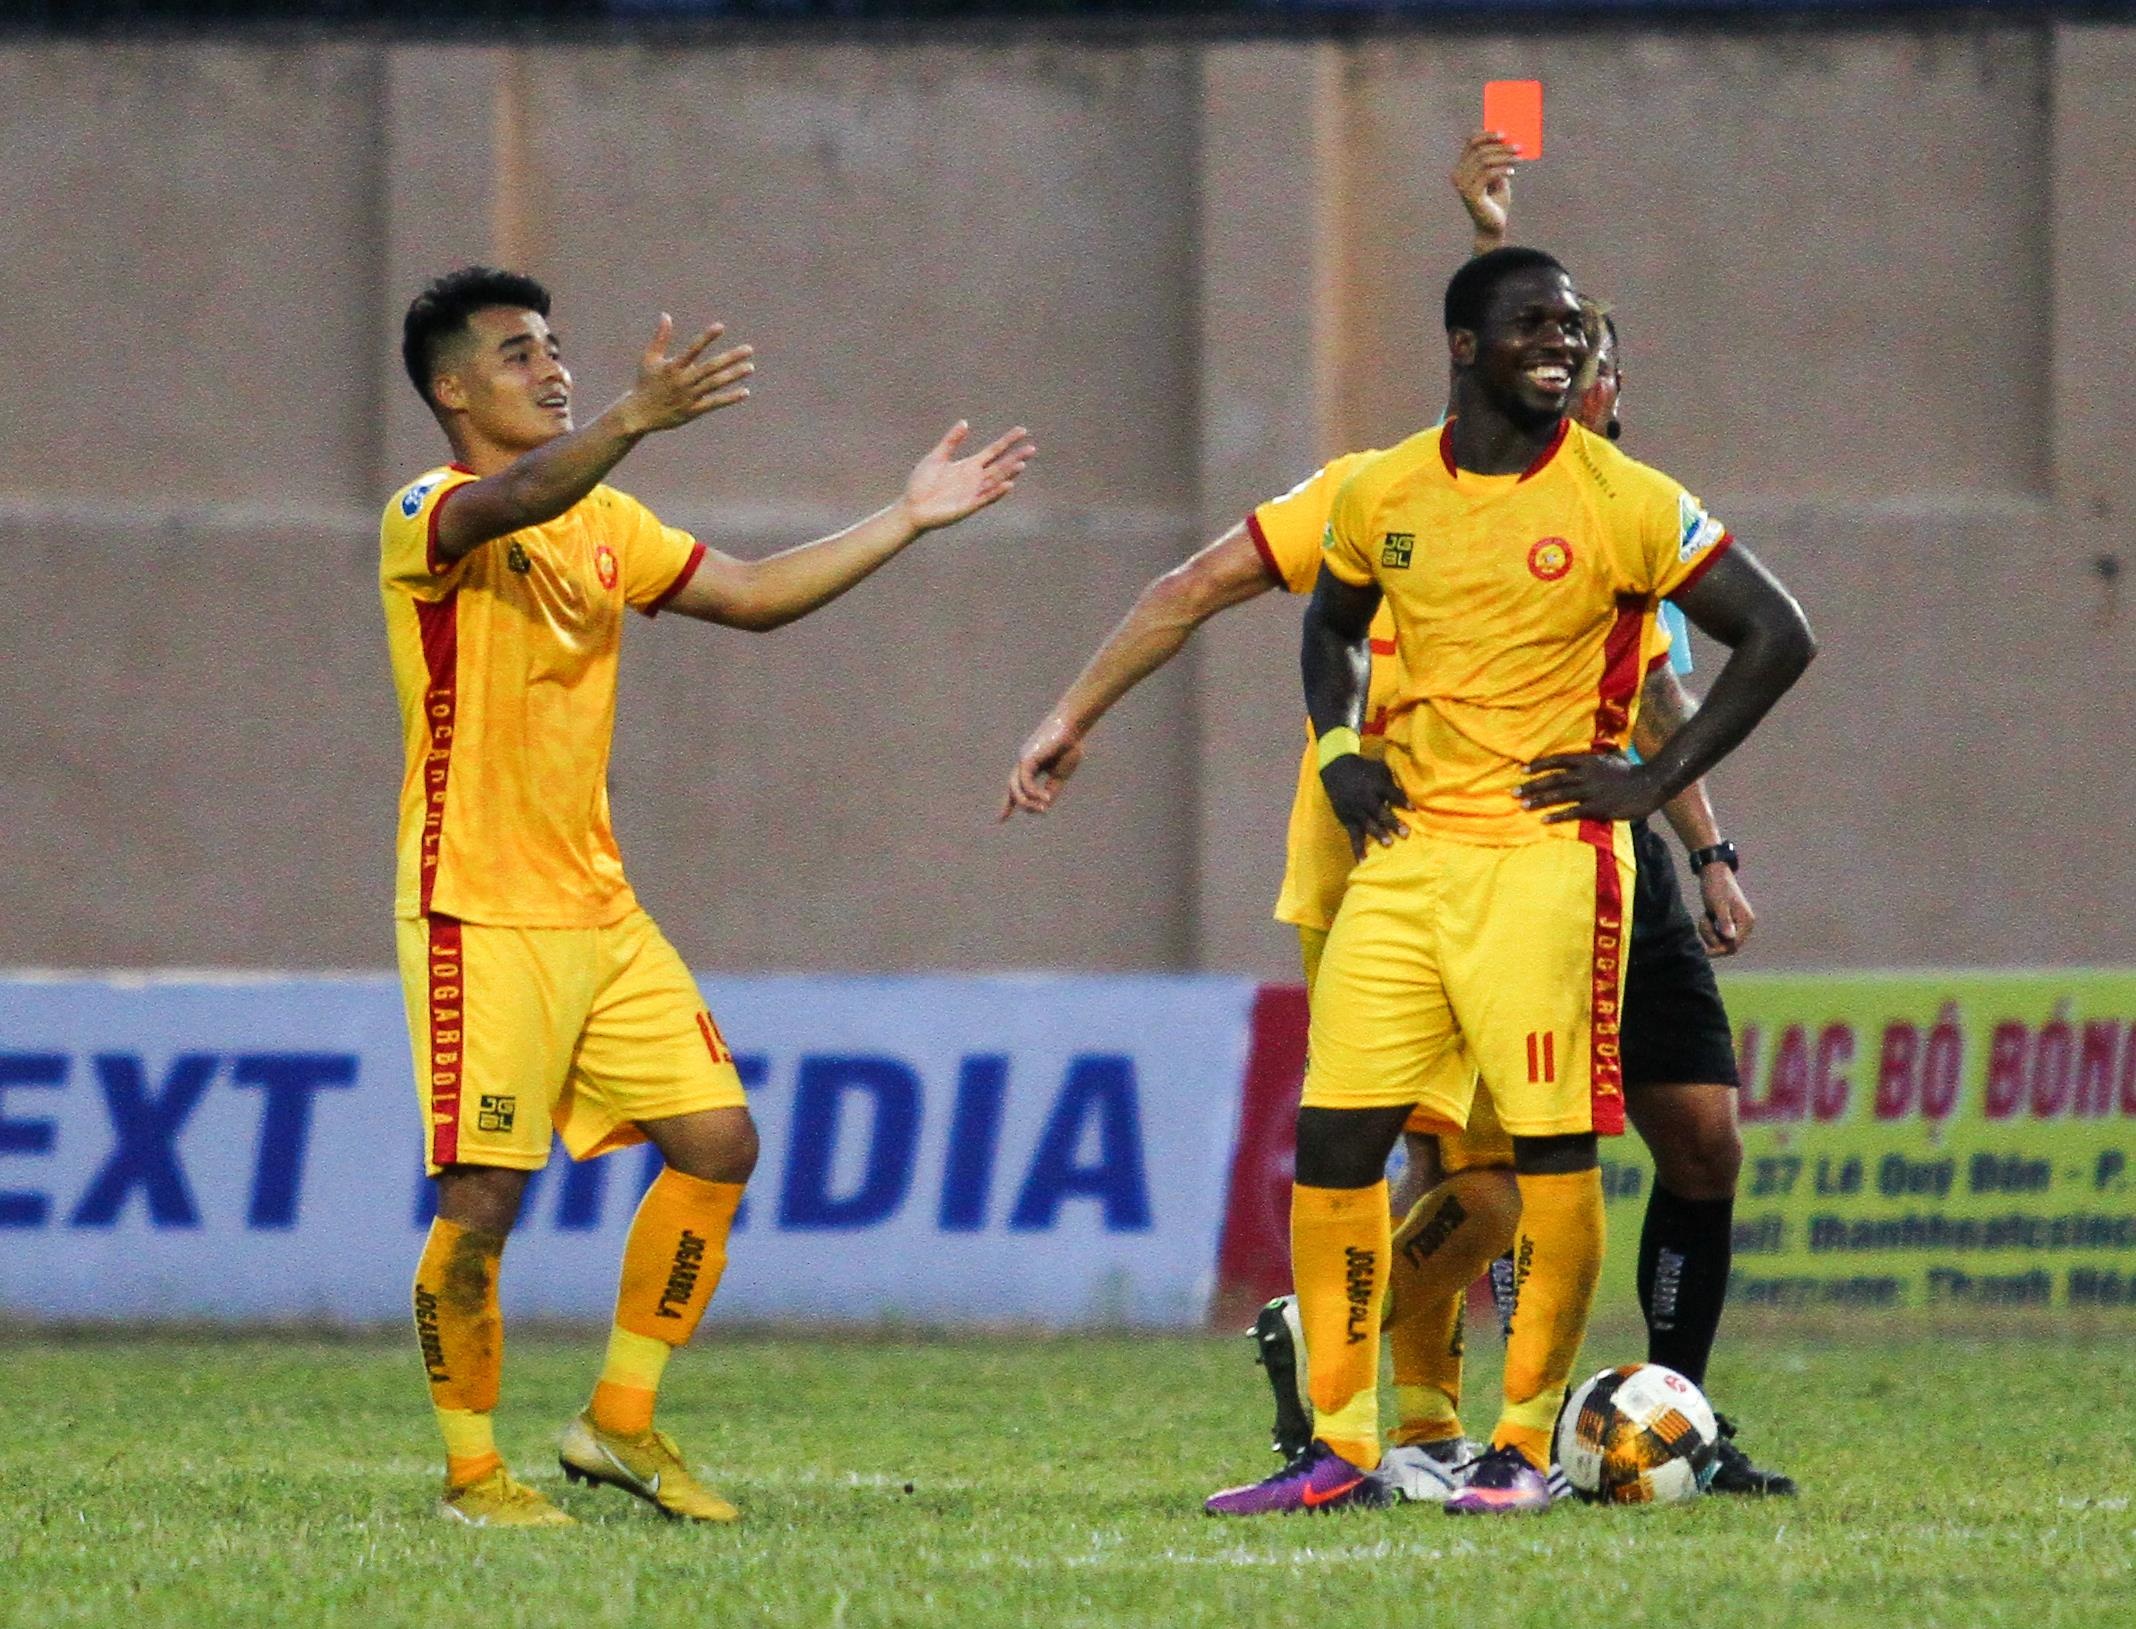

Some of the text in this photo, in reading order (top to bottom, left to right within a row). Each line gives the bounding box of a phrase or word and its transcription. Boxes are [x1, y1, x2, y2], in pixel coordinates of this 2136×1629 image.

[431, 944, 461, 1127] JOGARBOLA
[1527, 1030, 1556, 1084] 11
[655, 1228, 707, 1320] JOGARBOLA
